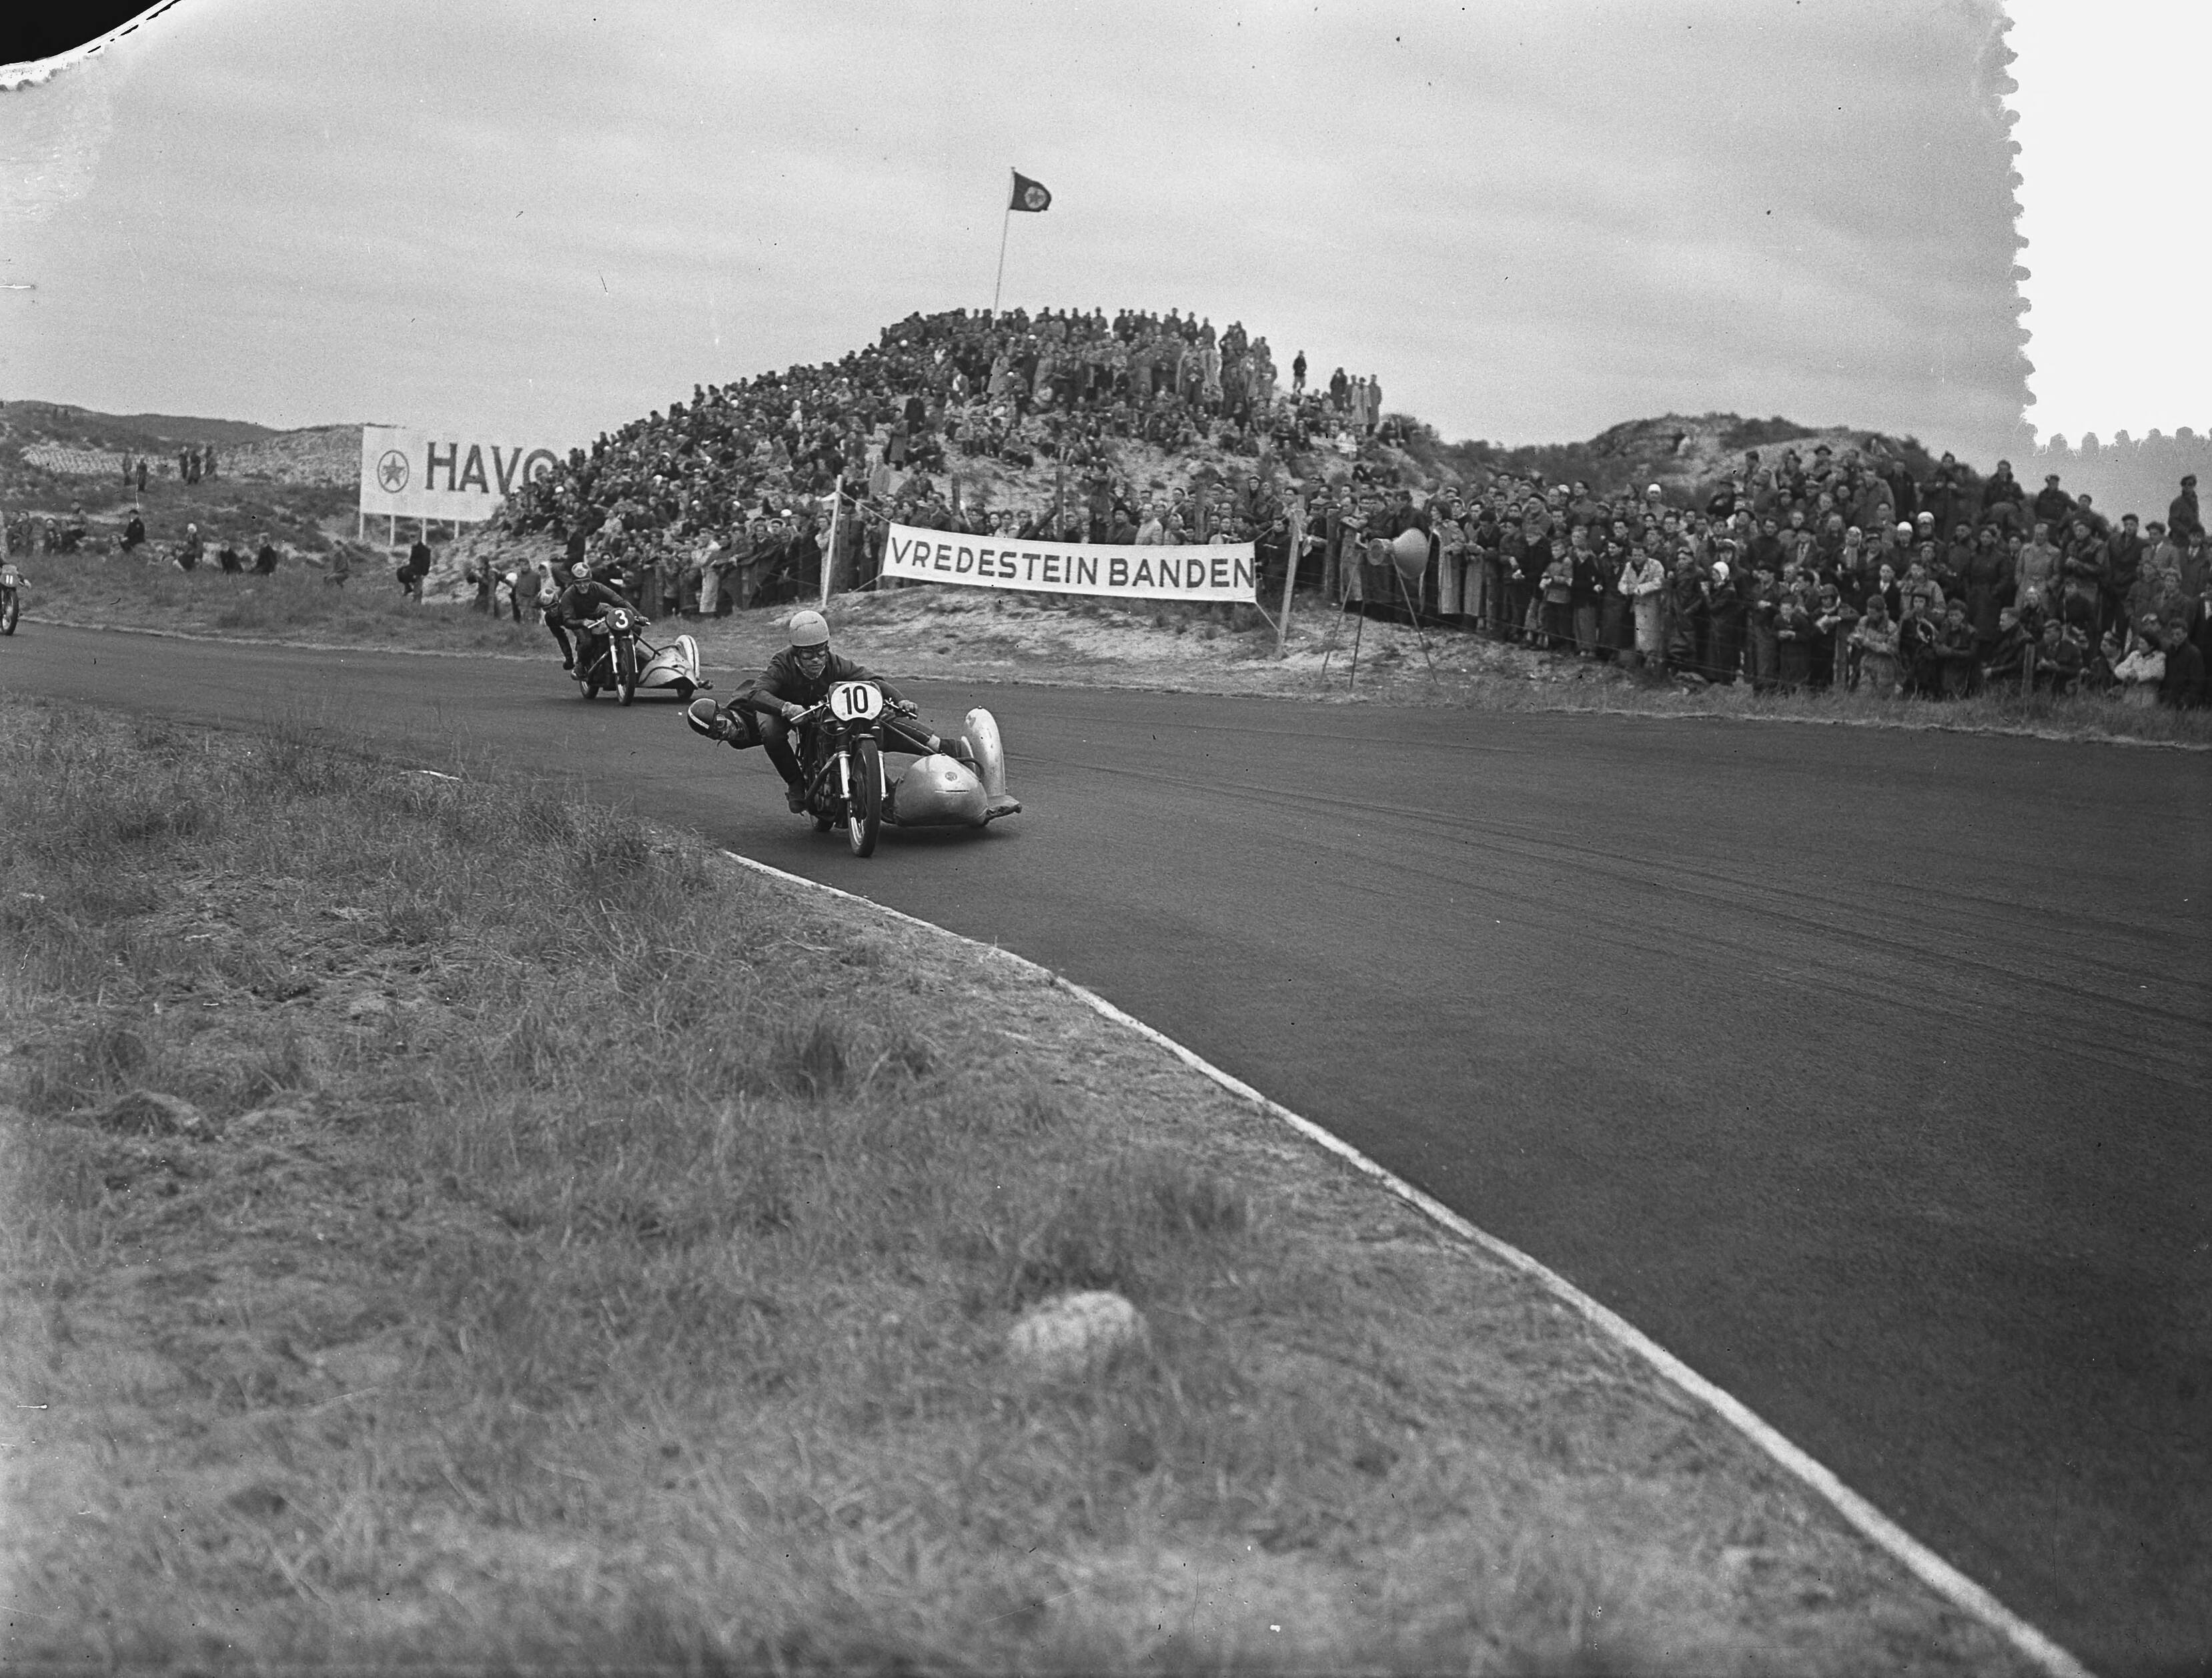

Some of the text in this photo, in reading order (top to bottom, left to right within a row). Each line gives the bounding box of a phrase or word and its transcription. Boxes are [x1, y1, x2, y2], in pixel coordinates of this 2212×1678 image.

[892, 537, 1254, 588] VREDESTEIN BANDEN
[614, 610, 628, 628] 3
[842, 685, 869, 715] 10
